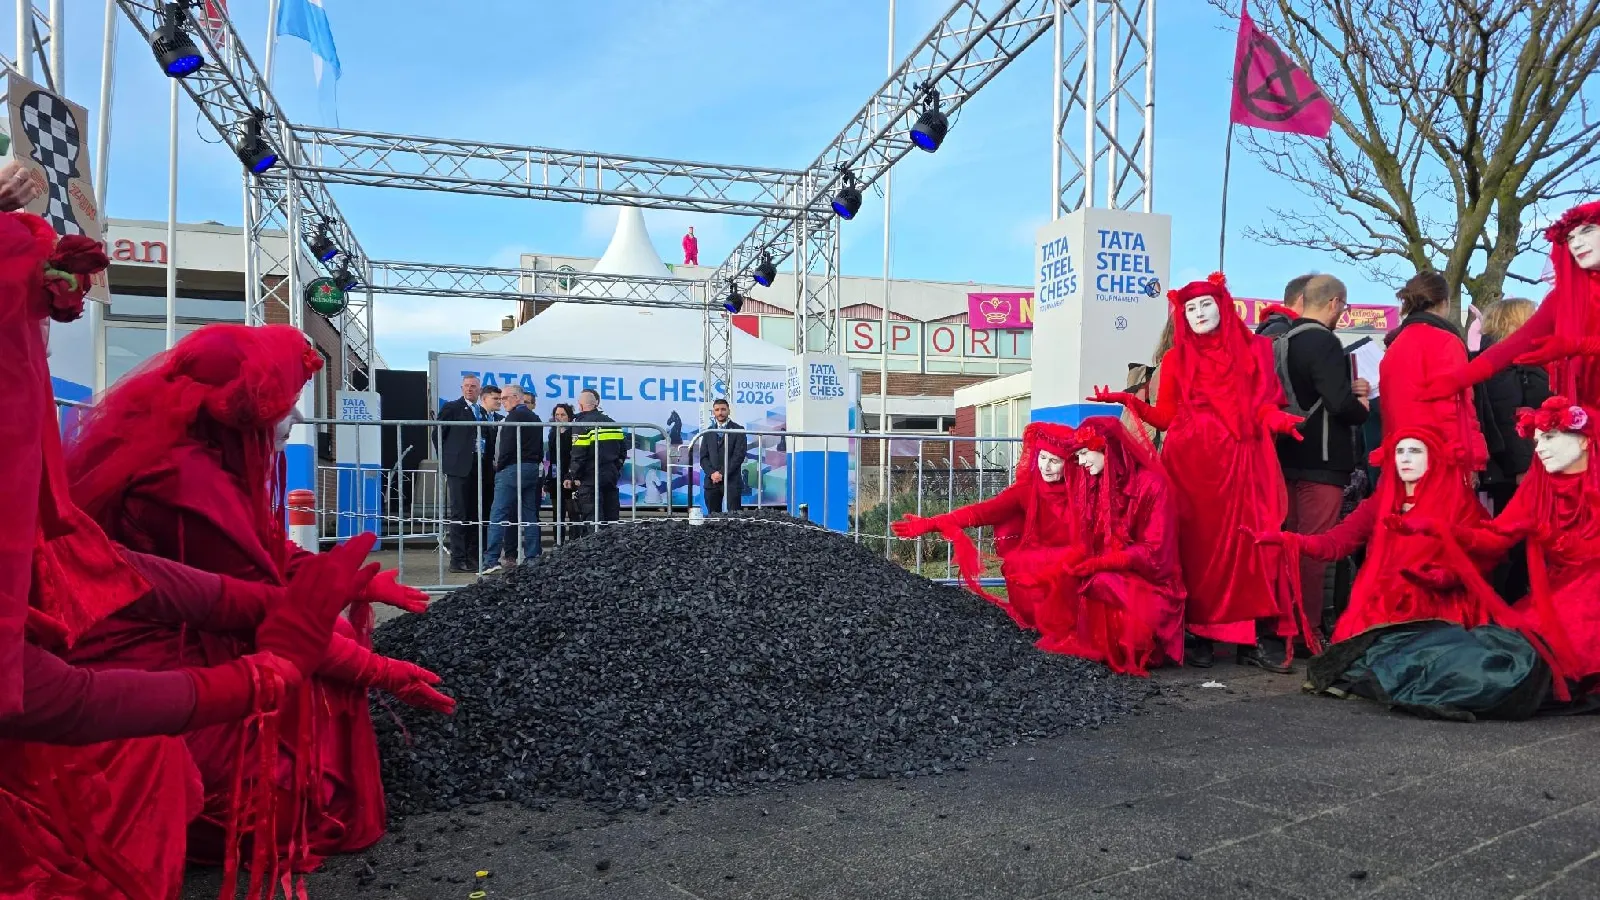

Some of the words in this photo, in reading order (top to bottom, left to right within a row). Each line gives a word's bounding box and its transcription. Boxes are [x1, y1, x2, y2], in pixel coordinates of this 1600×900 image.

[1097, 229, 1146, 252] TATA
[1041, 235, 1069, 263] TATA
[1040, 255, 1075, 283] STEEL
[1096, 251, 1155, 274] STEEL
[1039, 274, 1077, 304] CHESS
[1095, 293, 1140, 304] TOURNAMENT
[854, 321, 1025, 356] SPORT
[809, 363, 836, 375] TATA
[545, 373, 633, 401] STEEL
[736, 381, 787, 390] TOURNAME
[809, 374, 841, 386] STEEL
[736, 390, 775, 405] 2026
[809, 385, 845, 397] CHESS
[342, 398, 366, 406] TATA
[342, 406, 370, 415] STEEL
